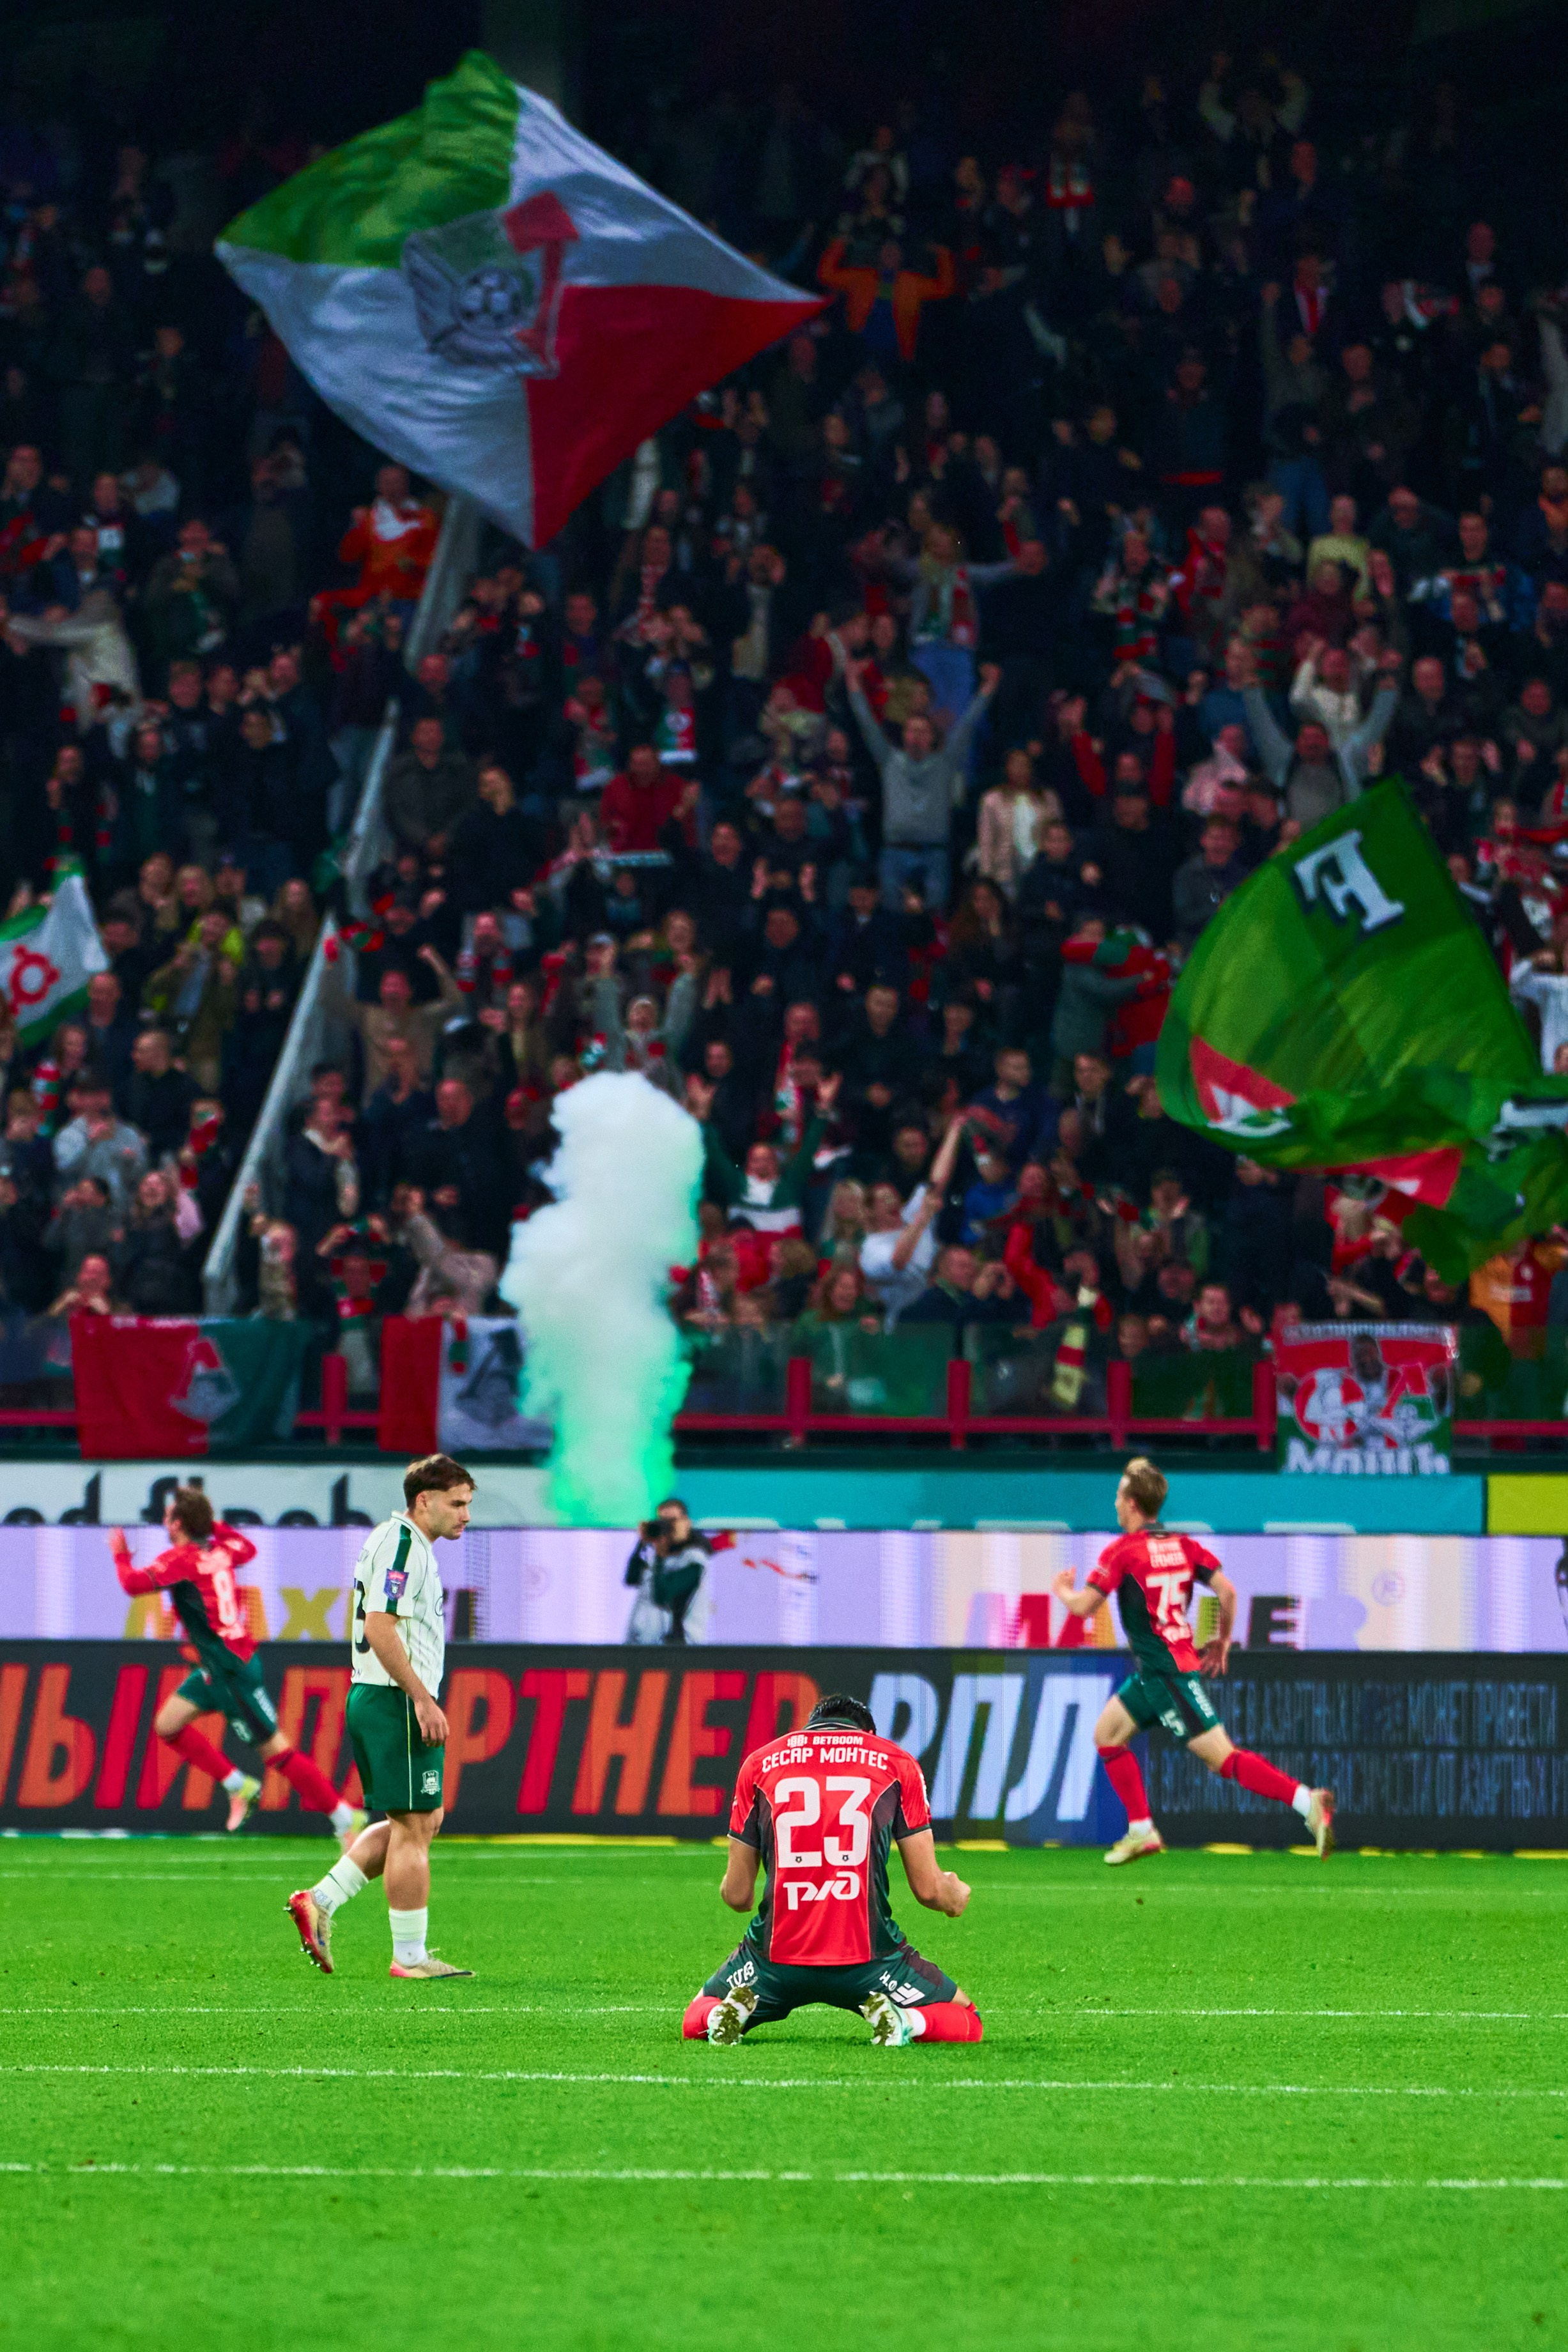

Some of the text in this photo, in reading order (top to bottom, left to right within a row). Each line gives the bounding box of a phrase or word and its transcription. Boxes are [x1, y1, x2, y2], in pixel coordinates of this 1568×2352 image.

[1145, 1571, 1191, 1626] 75
[762, 1748, 889, 1773] СЕСАР МОНТЕС
[813, 1735, 863, 1746] BETBOOM
[774, 1776, 871, 1868] 23
